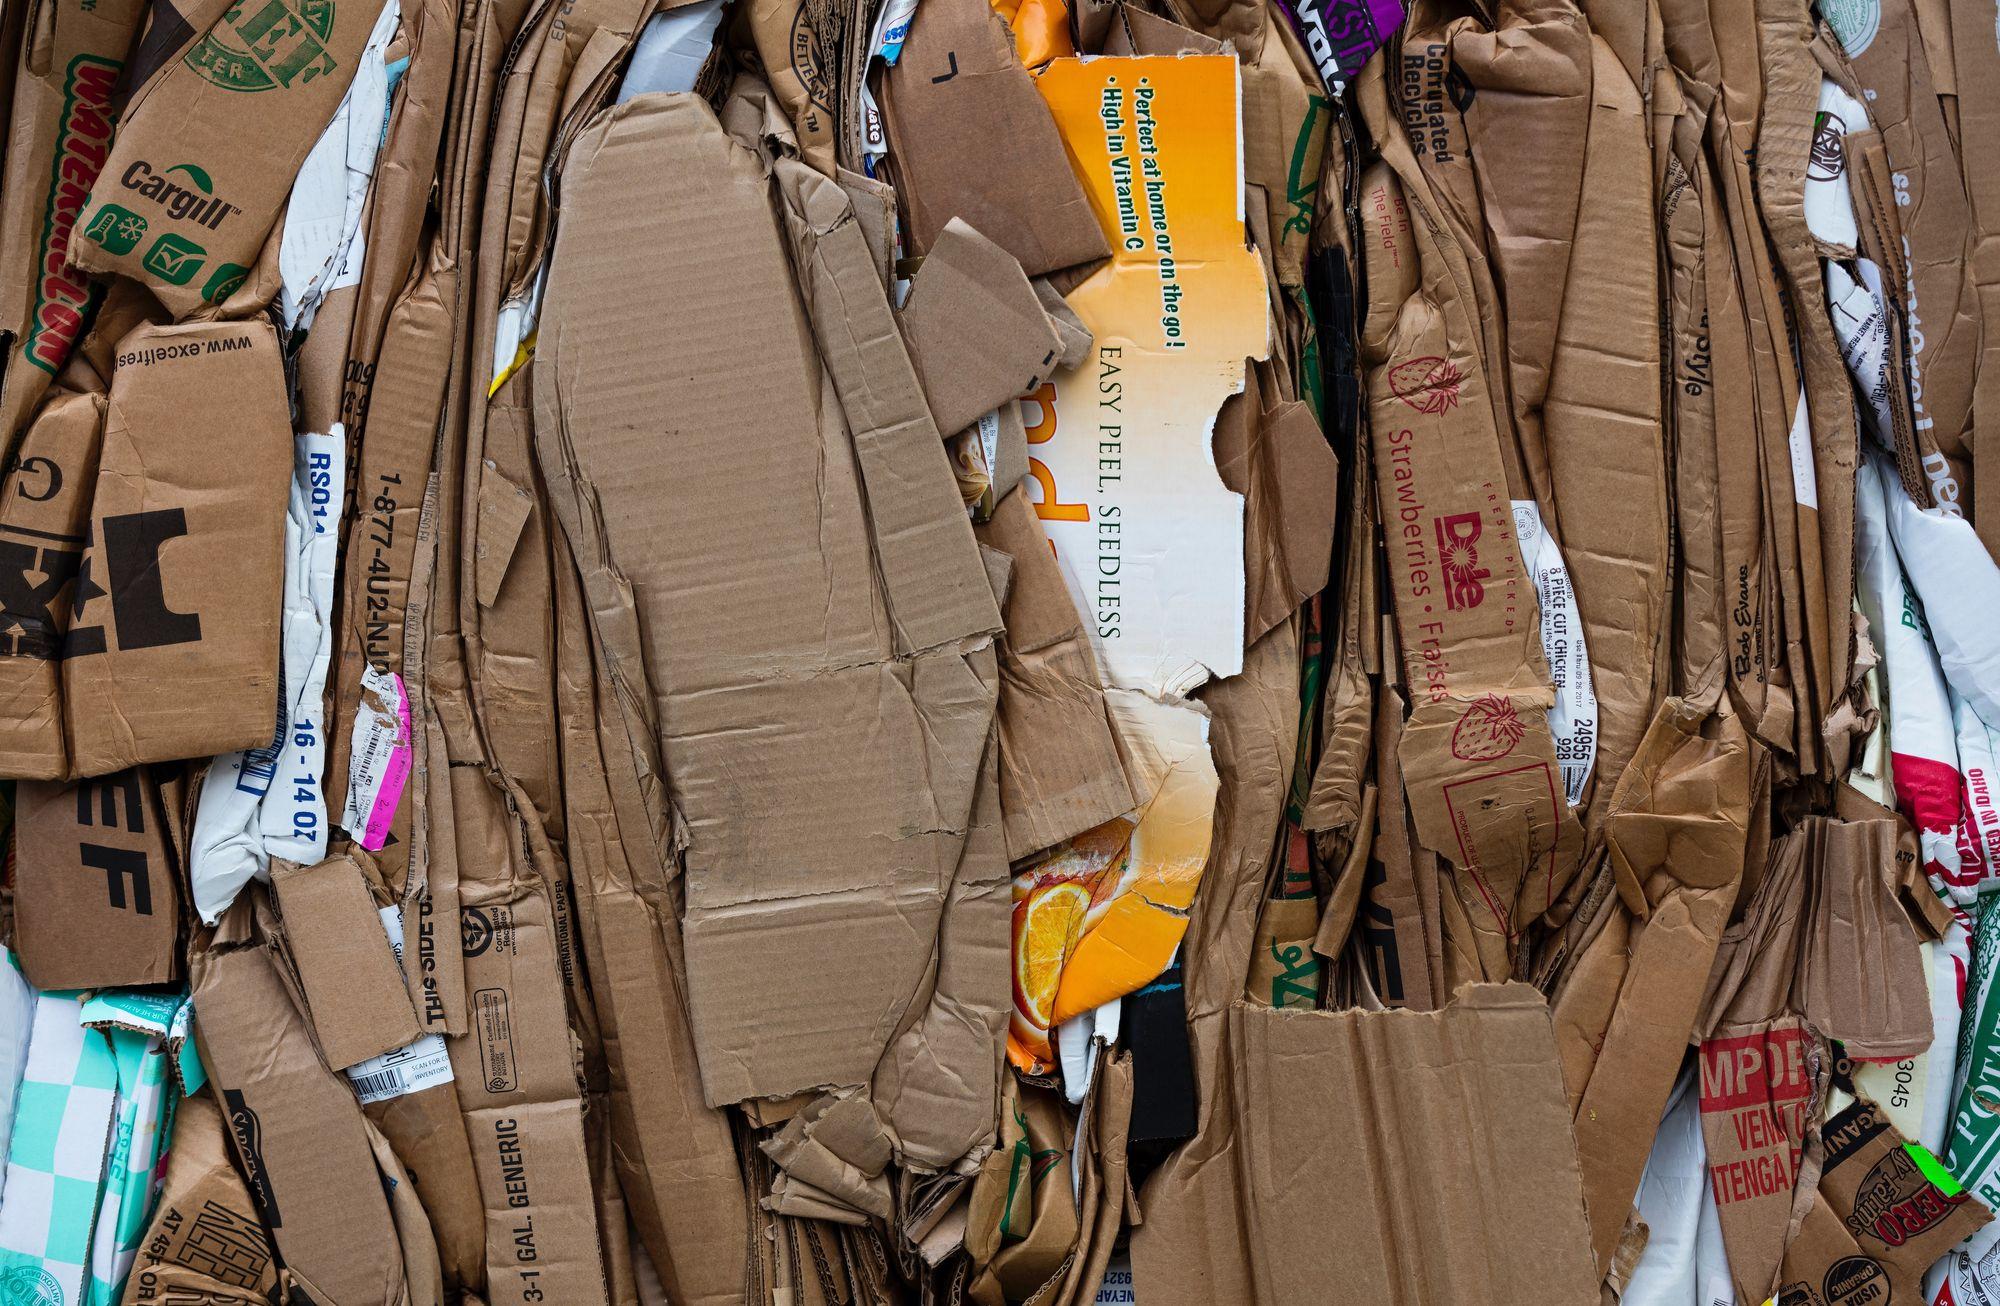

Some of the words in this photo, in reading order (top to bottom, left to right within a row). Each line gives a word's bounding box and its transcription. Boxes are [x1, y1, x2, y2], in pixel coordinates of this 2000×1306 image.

[1100, 87, 1123, 131] High
[1135, 87, 1160, 155] Perfect
[1403, 54, 1428, 157] Recycles
[1426, 43, 1454, 164] Corrugated
[1109, 134, 1126, 154] in
[1143, 156, 1163, 178] at
[121, 160, 229, 231] Cargill
[1111, 156, 1139, 233] Vitamin
[1146, 180, 1168, 228] home
[1371, 187, 1386, 210] The
[1394, 198, 1406, 214] Be
[1125, 236, 1144, 251] C
[1154, 230, 1173, 254] or
[1377, 212, 1394, 250] Field
[1397, 216, 1407, 232] In
[1159, 256, 1176, 281] on
[1160, 284, 1183, 314] the
[1099, 345, 1122, 413] EASY
[1098, 424, 1122, 493] PEEL,
[1098, 504, 1121, 639] SEEDLESS
[1388, 429, 1431, 597] Strawberries
[1418, 621, 1449, 704] Fraises
[1443, 511, 1491, 609] Dole
[1482, 481, 1510, 541] FRESH
[1503, 556, 1514, 628] PICKED
[1549, 567, 1561, 575] 8
[1551, 578, 1566, 609] PIECE
[1733, 564, 1749, 627] Evans
[1553, 613, 1567, 635] CUT
[1555, 639, 1567, 689] CHICKEN
[1735, 627, 1752, 682] Bob
[294, 718, 316, 746] 16
[1556, 737, 1572, 761] 928
[1572, 718, 1593, 761] 24955
[293, 773, 316, 803] 14
[1968, 768, 1991, 808] IDAHO
[1980, 808, 1998, 827] IN
[554, 878, 566, 911] PAPER
[495, 907, 504, 954] Corrugated
[503, 911, 511, 947] Recycles
[559, 912, 573, 986] INTERNATIONAL
[426, 979, 445, 1026] THIS
[413, 1066, 449, 1081] INVENTORY
[1891, 1060, 1914, 1108] 3045
[496, 1118, 529, 1210] GENERIC
[161, 1206, 184, 1232] AT
[1846, 1163, 1901, 1237] Farms
[511, 1214, 538, 1263] GAL.
[523, 1271, 544, 1303] 3-1
[1104, 1272, 1133, 1286] 9321
[1831, 1262, 1876, 1298] ORGANIC
